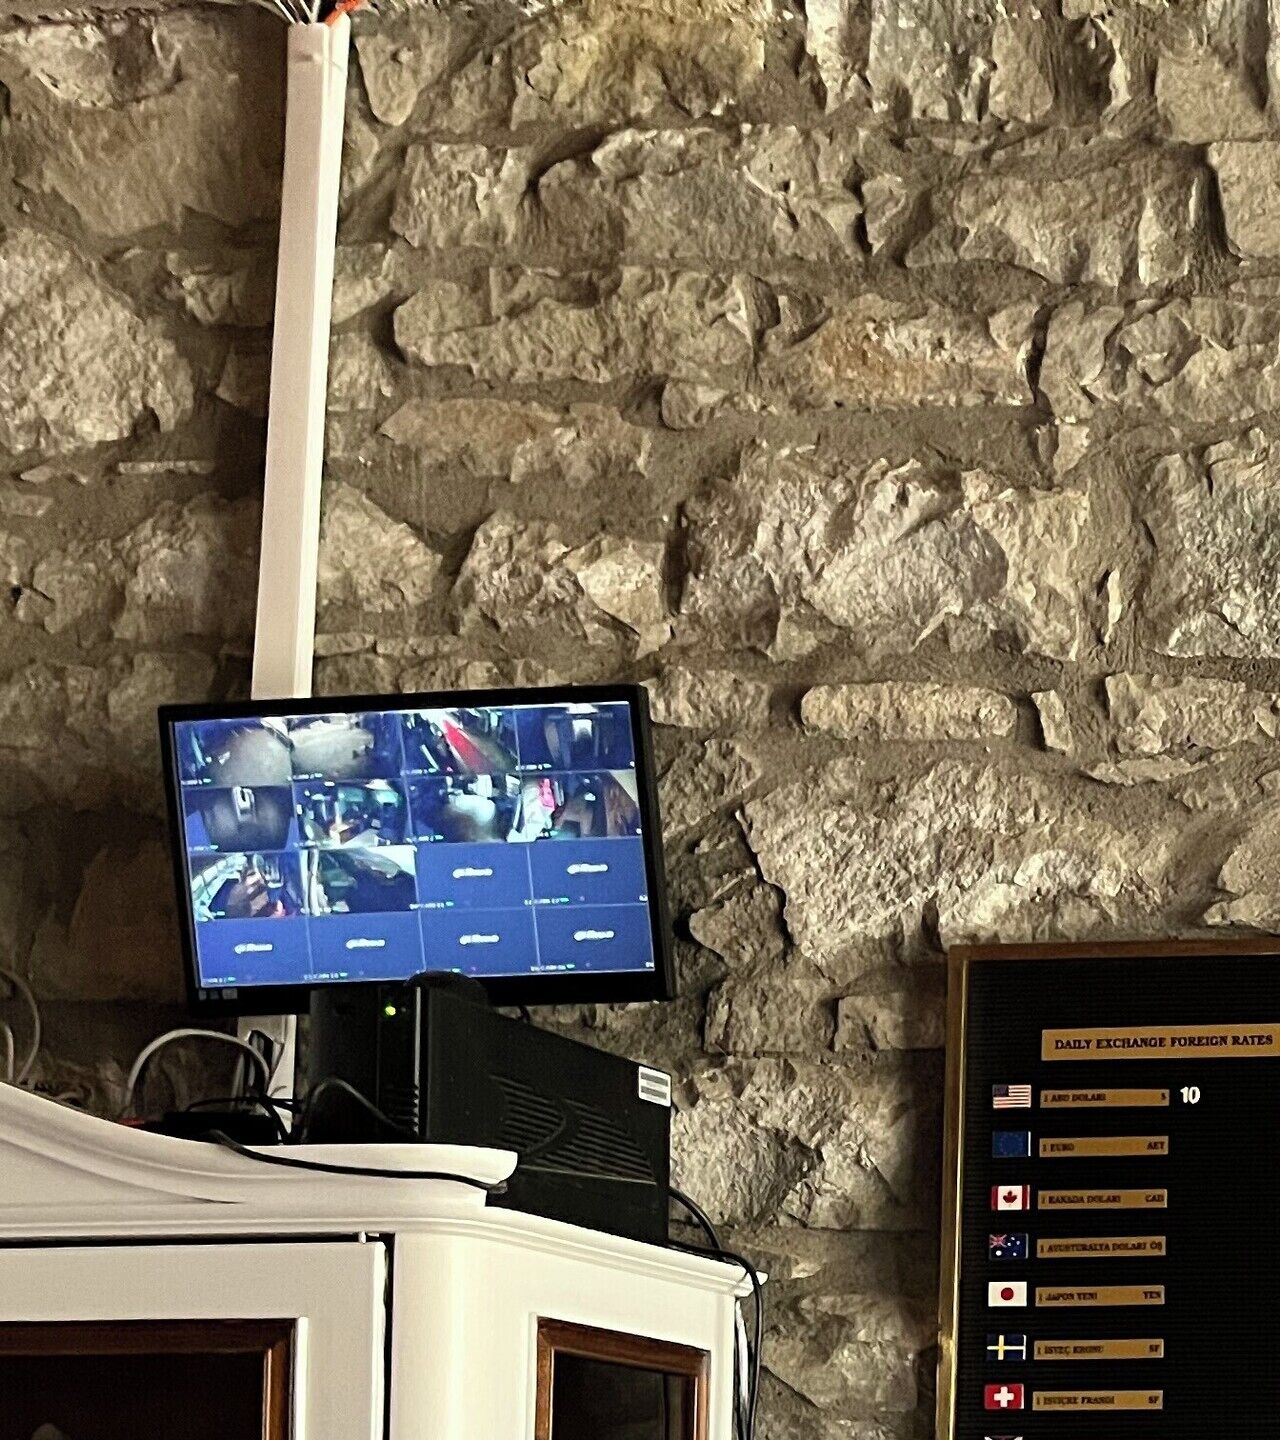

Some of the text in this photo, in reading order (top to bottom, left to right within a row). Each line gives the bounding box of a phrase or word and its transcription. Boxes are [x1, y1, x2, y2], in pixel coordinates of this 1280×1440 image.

[1055, 1034, 1273, 1050] DAILY EXCHANGE FOREIGN RATES
[1180, 1086, 1200, 1105] 10
